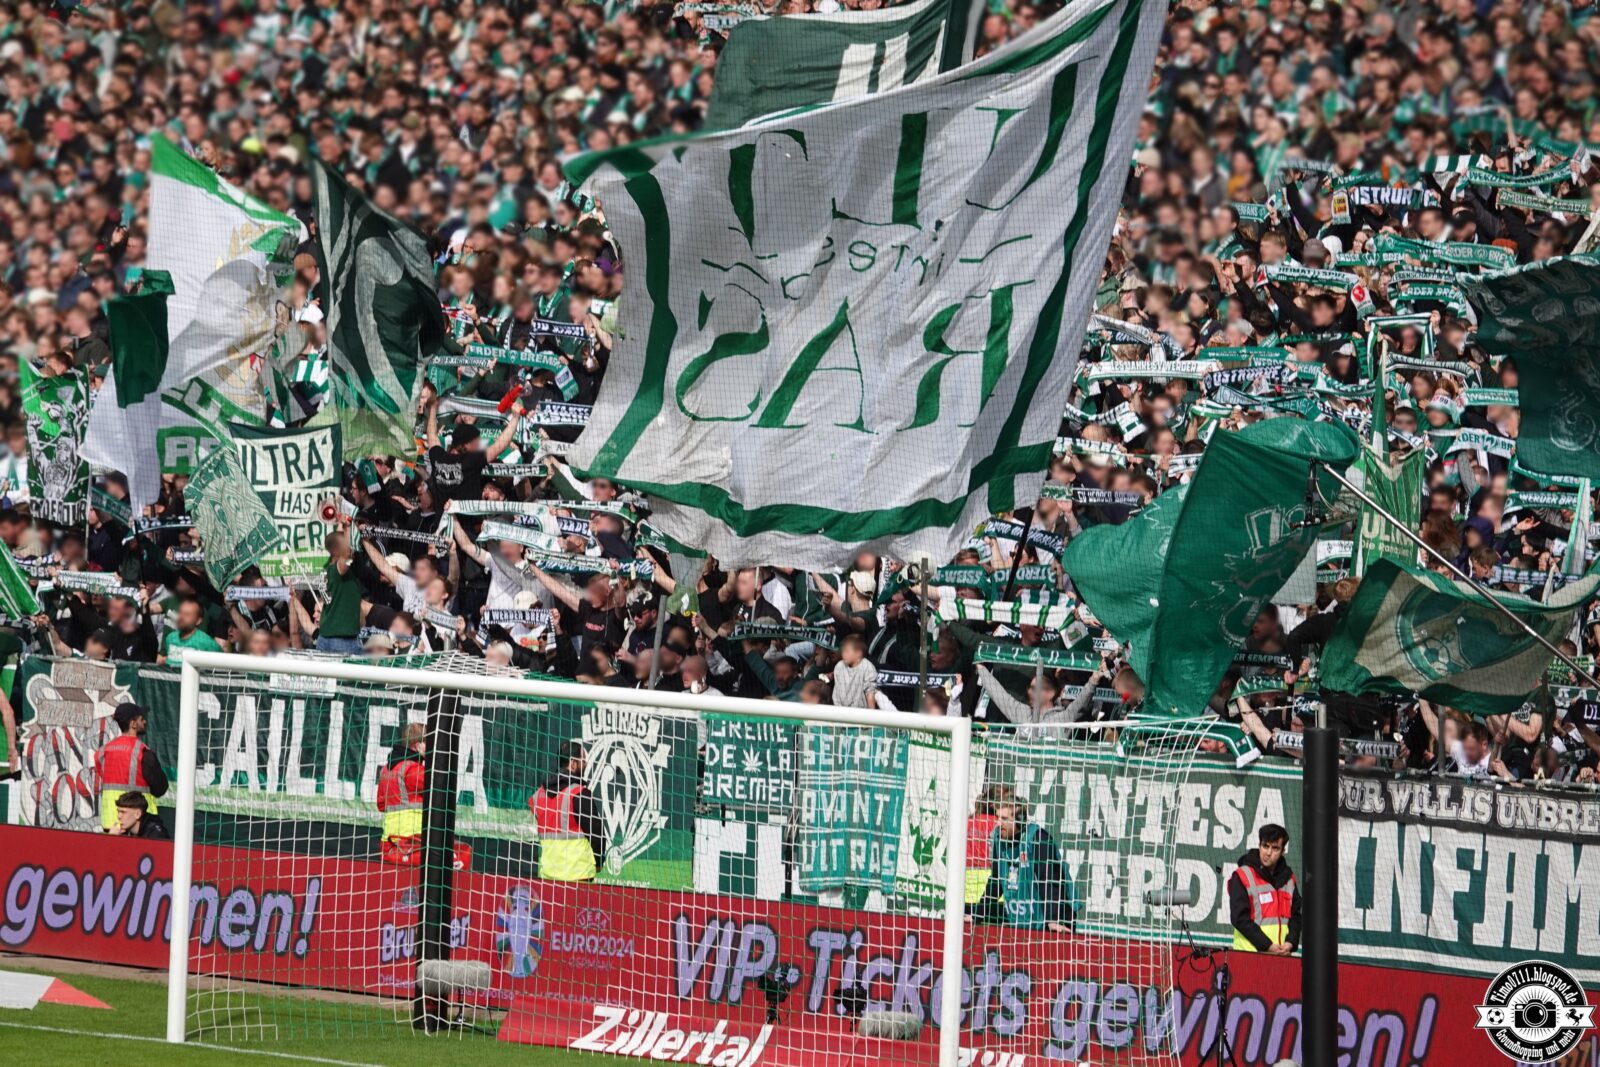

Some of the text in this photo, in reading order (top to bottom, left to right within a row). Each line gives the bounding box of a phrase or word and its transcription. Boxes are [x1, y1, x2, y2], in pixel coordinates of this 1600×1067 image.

[280, 491, 313, 516] HAS
[592, 707, 648, 738] ULTRAS
[909, 729, 933, 744] NON
[706, 743, 790, 773] DE LA
[803, 731, 905, 769] SEMPRE
[703, 773, 794, 803] BREMEN
[1387, 780, 1458, 820] WILL
[1460, 784, 1493, 824] IS
[802, 789, 900, 828] AVANTI
[0, 856, 323, 956] gewinnen!
[577, 908, 610, 930] UEFA
[569, 1004, 772, 1067] Zillertal
